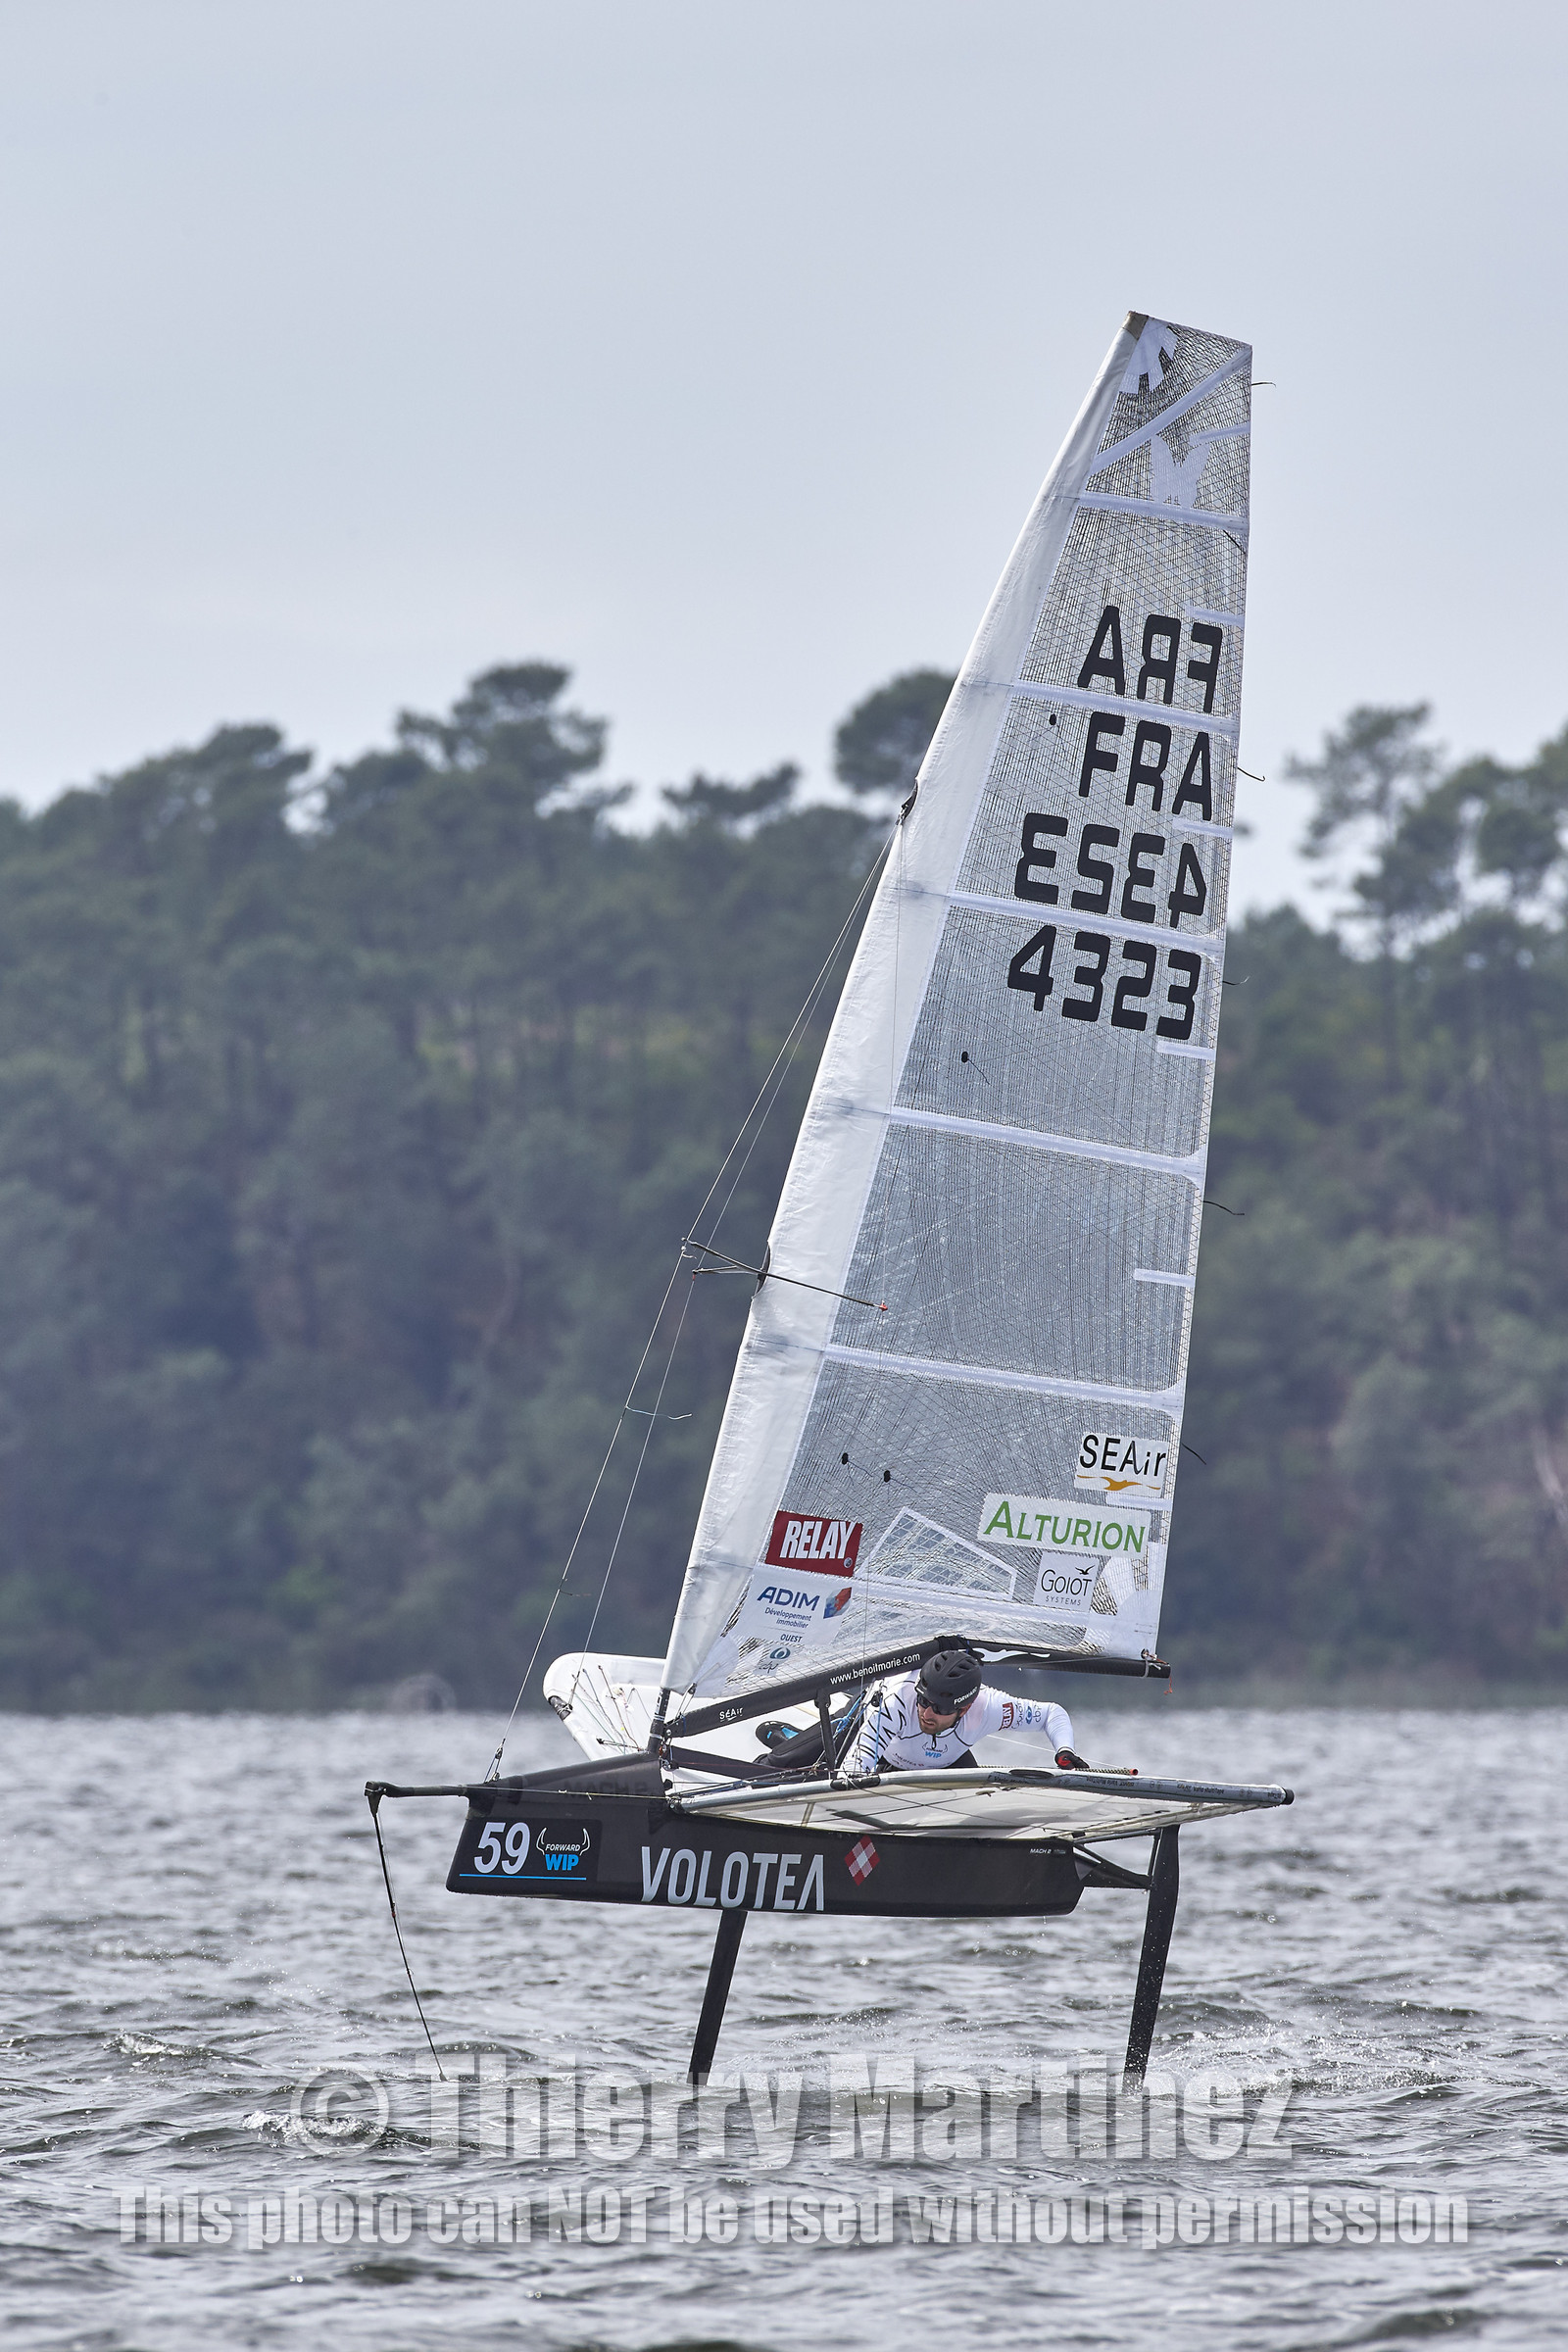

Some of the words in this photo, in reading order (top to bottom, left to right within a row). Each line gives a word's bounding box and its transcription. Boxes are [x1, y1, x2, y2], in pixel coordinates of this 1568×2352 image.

[1078, 710, 1212, 821] FRA
[1007, 924, 1201, 1041] 4323
[1079, 1434, 1166, 1477] SEAir
[779, 1520, 857, 1559] RELAY
[983, 1500, 1146, 1553] ALTURION
[1041, 1569, 1093, 1596] GOIOT
[757, 1586, 820, 1611] ADIM
[1045, 1594, 1082, 1606] SYSTEMS
[764, 1606, 812, 1622] Développement
[780, 1633, 804, 1643] OUEST
[829, 1652, 921, 1686] www.benoitmarie.com
[954, 1686, 978, 1705] FORWARD
[924, 1750, 942, 1759] WIP
[473, 1822, 530, 1876] 59
[545, 1843, 581, 1852] FORWARD
[545, 1853, 580, 1871] WIP
[641, 1845, 824, 1912] VOLOTEA
